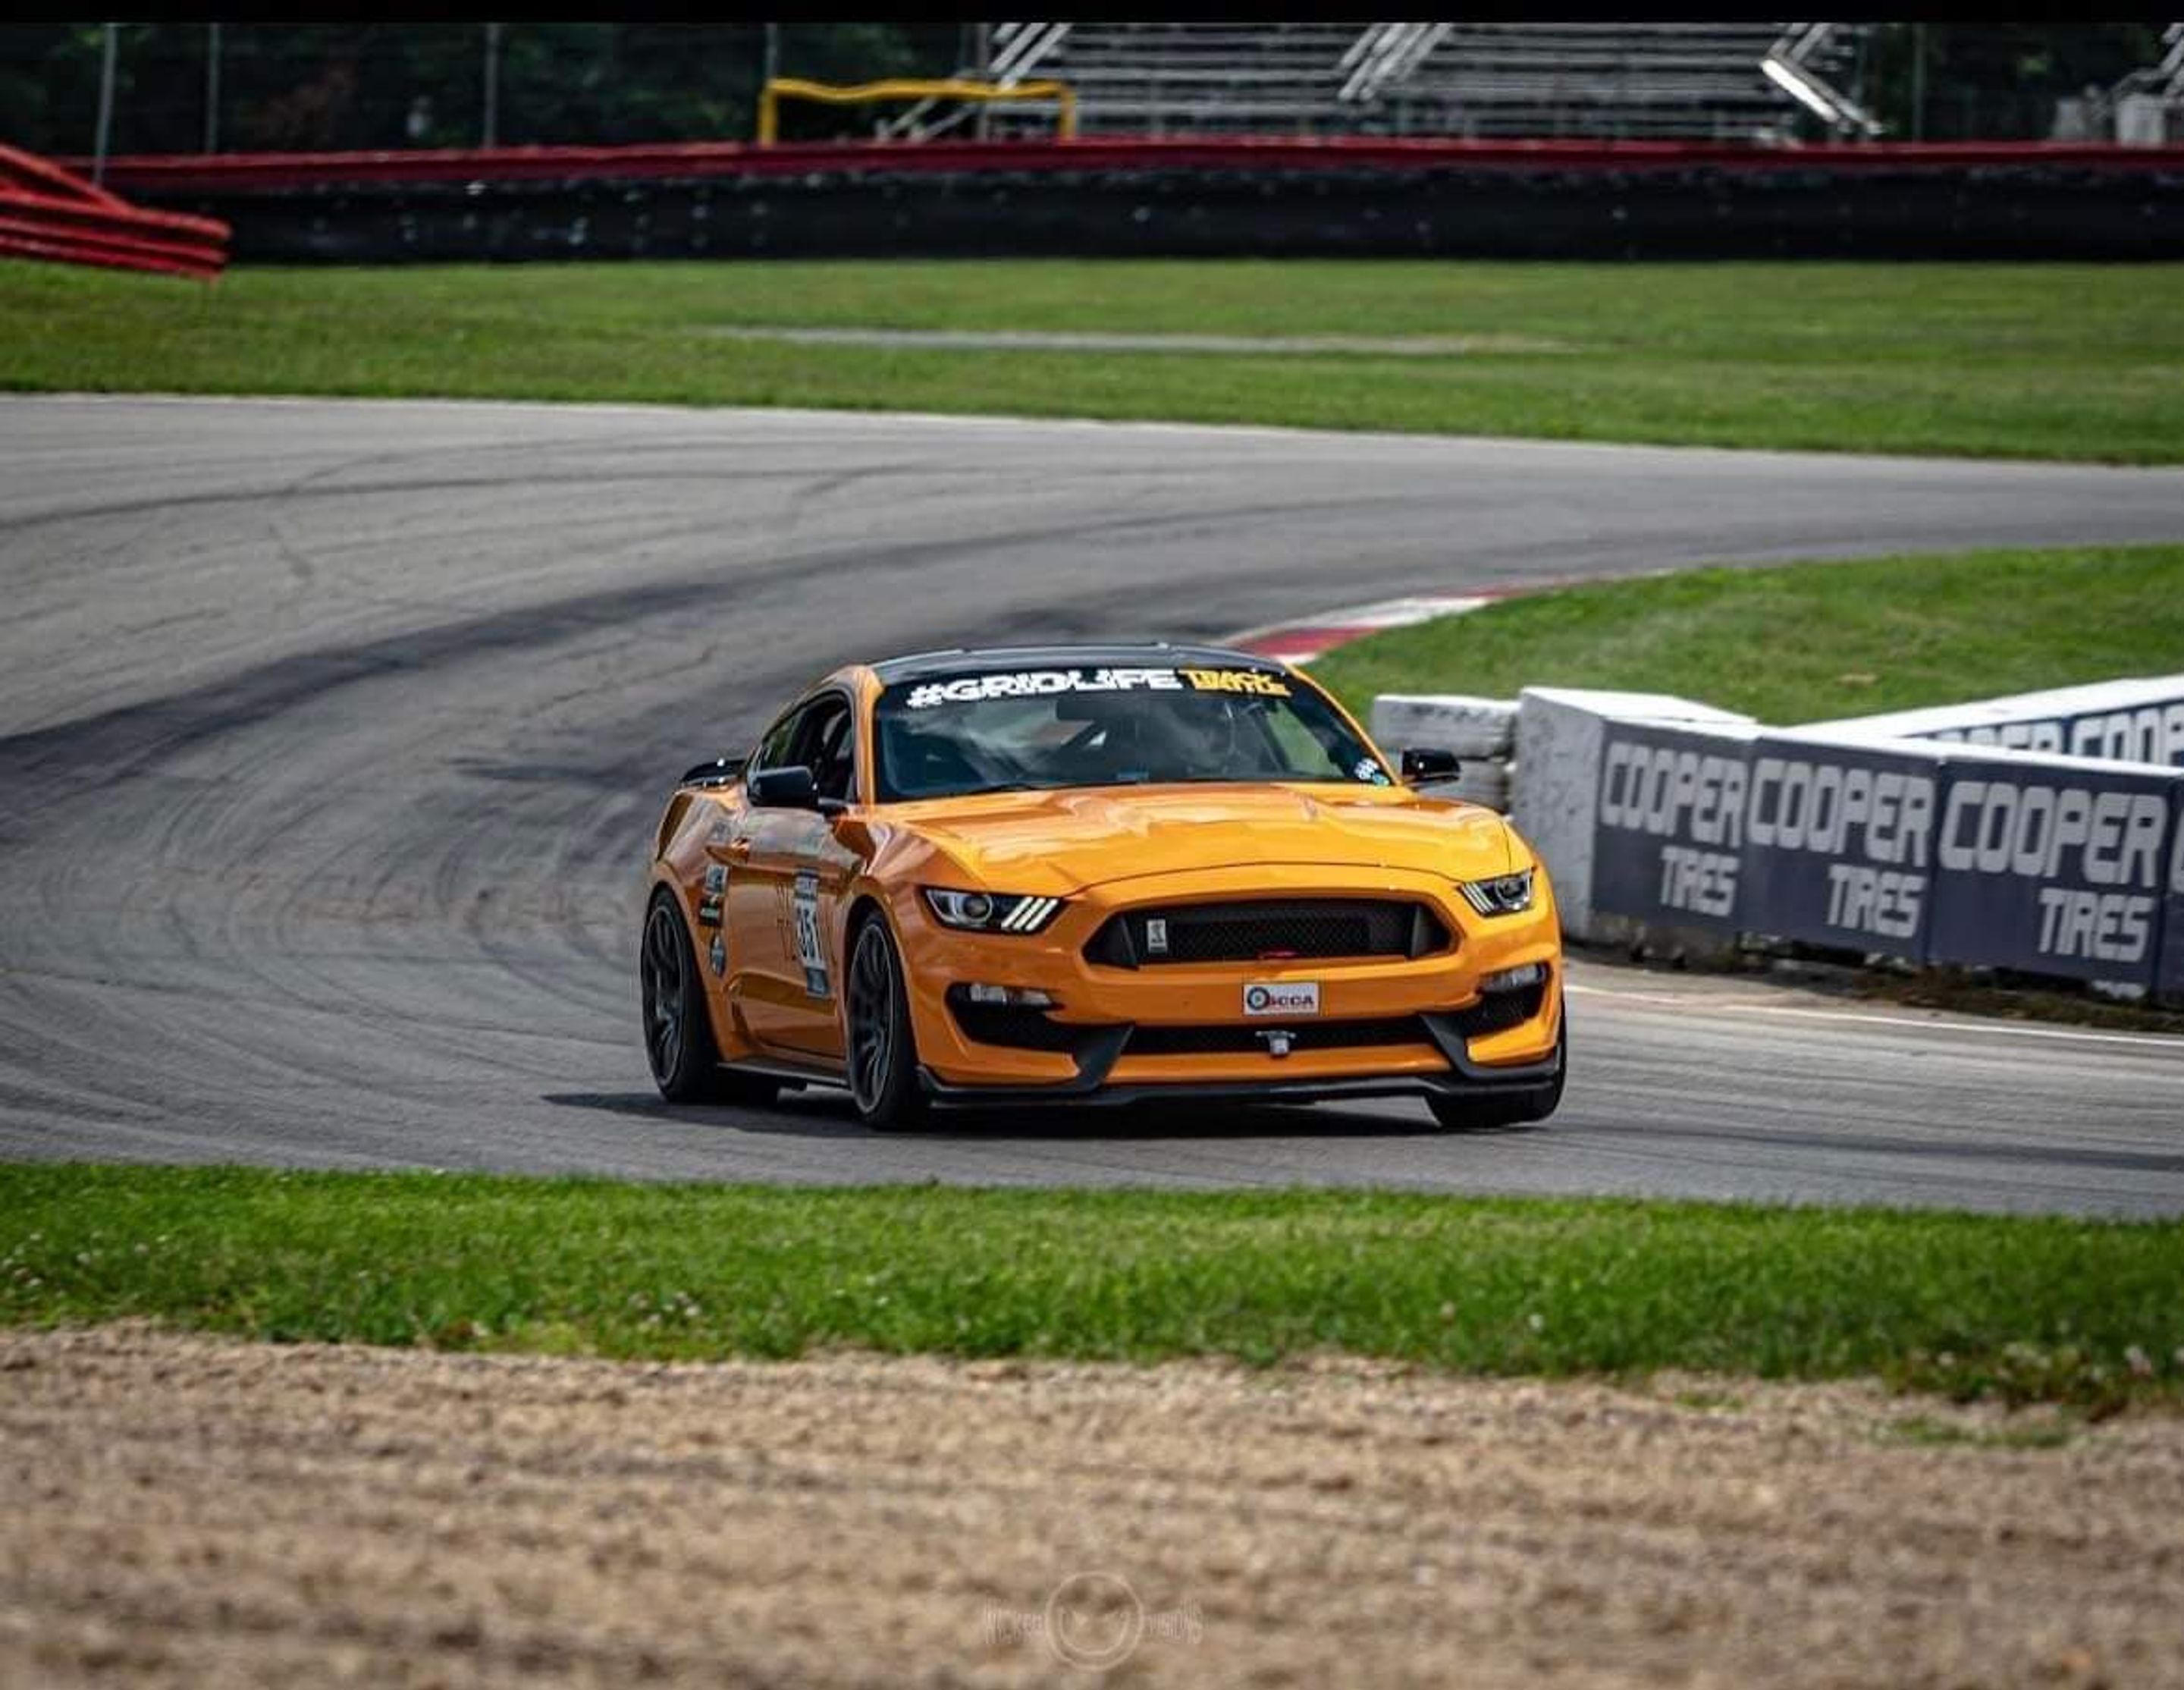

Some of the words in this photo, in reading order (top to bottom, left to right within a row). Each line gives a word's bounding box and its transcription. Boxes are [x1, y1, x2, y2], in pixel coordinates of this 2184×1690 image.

[906, 669, 1183, 708] #GRIDLIFE
[1601, 741, 1749, 849] COOPER
[1748, 758, 1935, 867] COOPER
[1938, 781, 2168, 887] COOPER
[1828, 863, 1926, 938] TIRES
[2038, 887, 2155, 963] TIRES
